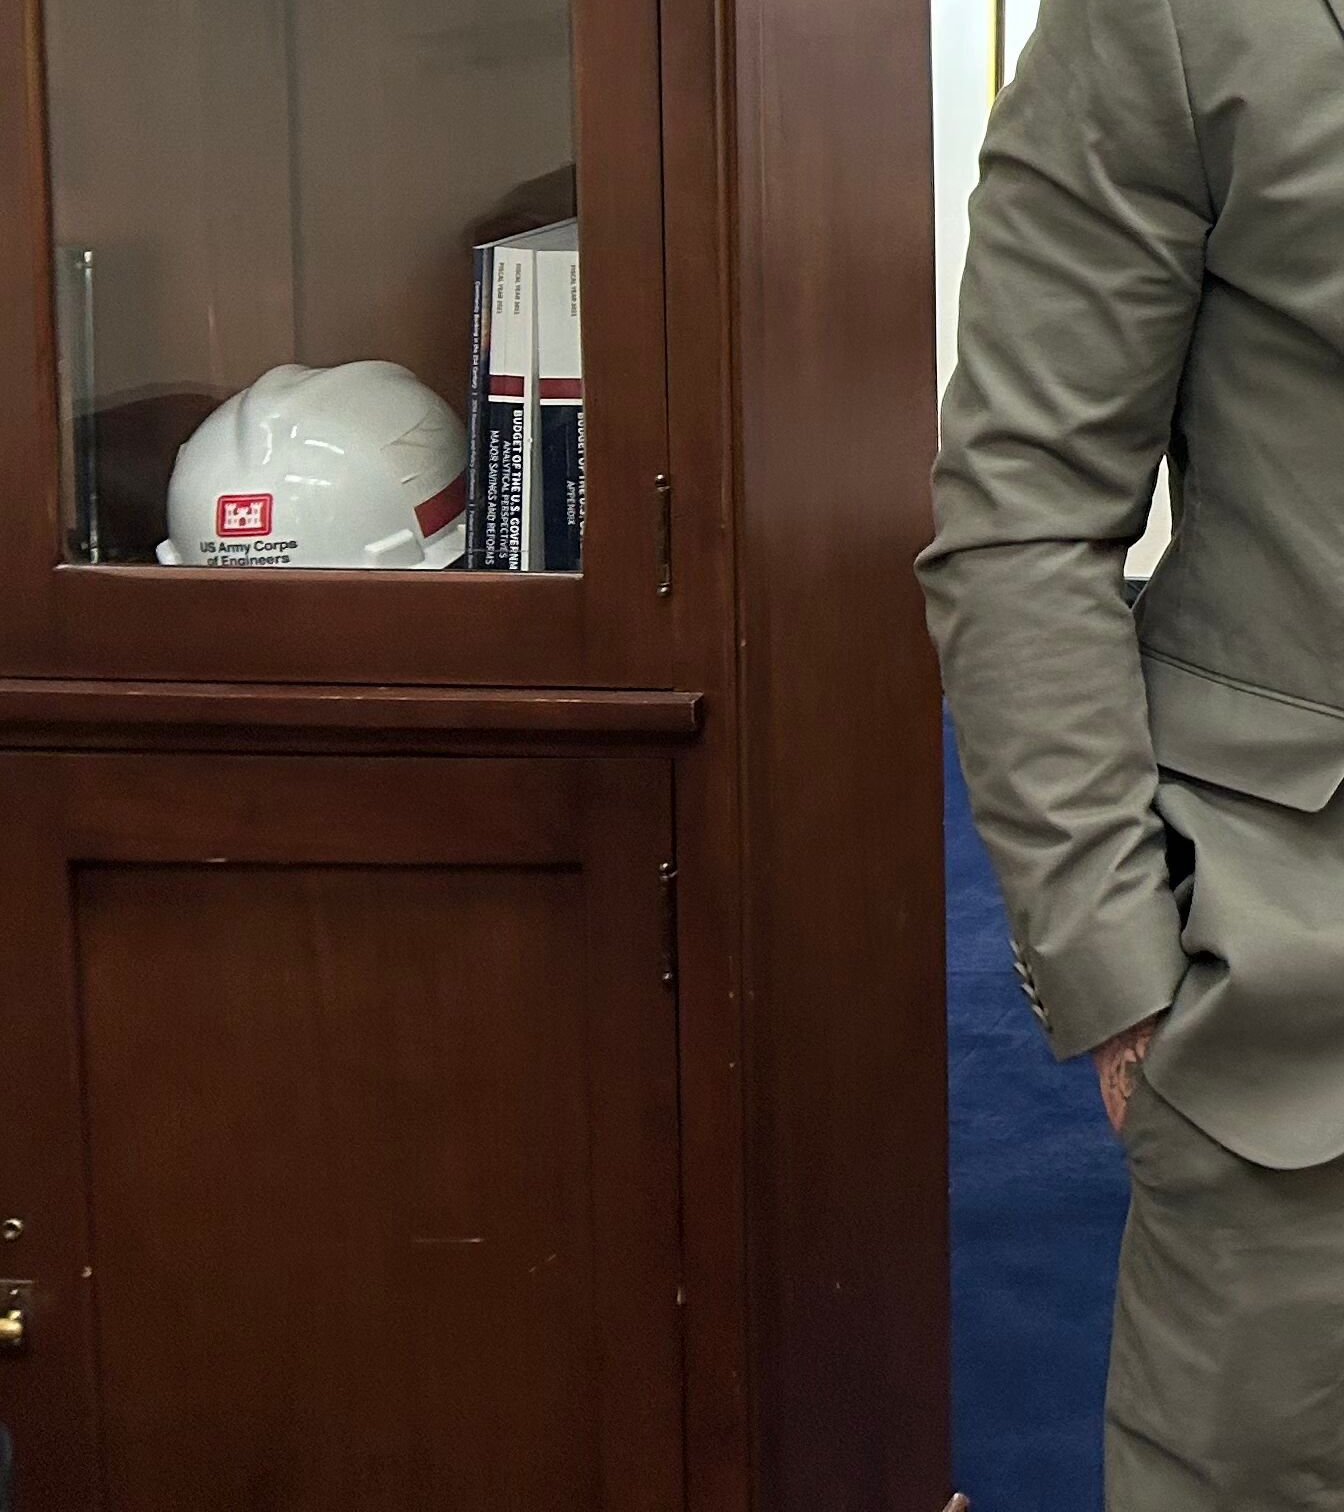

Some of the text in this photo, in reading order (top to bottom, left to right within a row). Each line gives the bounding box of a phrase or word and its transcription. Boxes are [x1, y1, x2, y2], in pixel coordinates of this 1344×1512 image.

[512, 409, 523, 454] BUDGET
[511, 454, 522, 469] OF
[510, 471, 522, 493] THE
[485, 429, 501, 566] MAJOR SAVINGS AND REFORMS
[498, 439, 512, 559] ANALYTICAL PERSPECTIVES
[509, 494, 521, 516] U.S.
[566, 479, 577, 526] APPENDIX
[200, 539, 298, 555] US Army Corps
[206, 554, 291, 567] of Engineers
